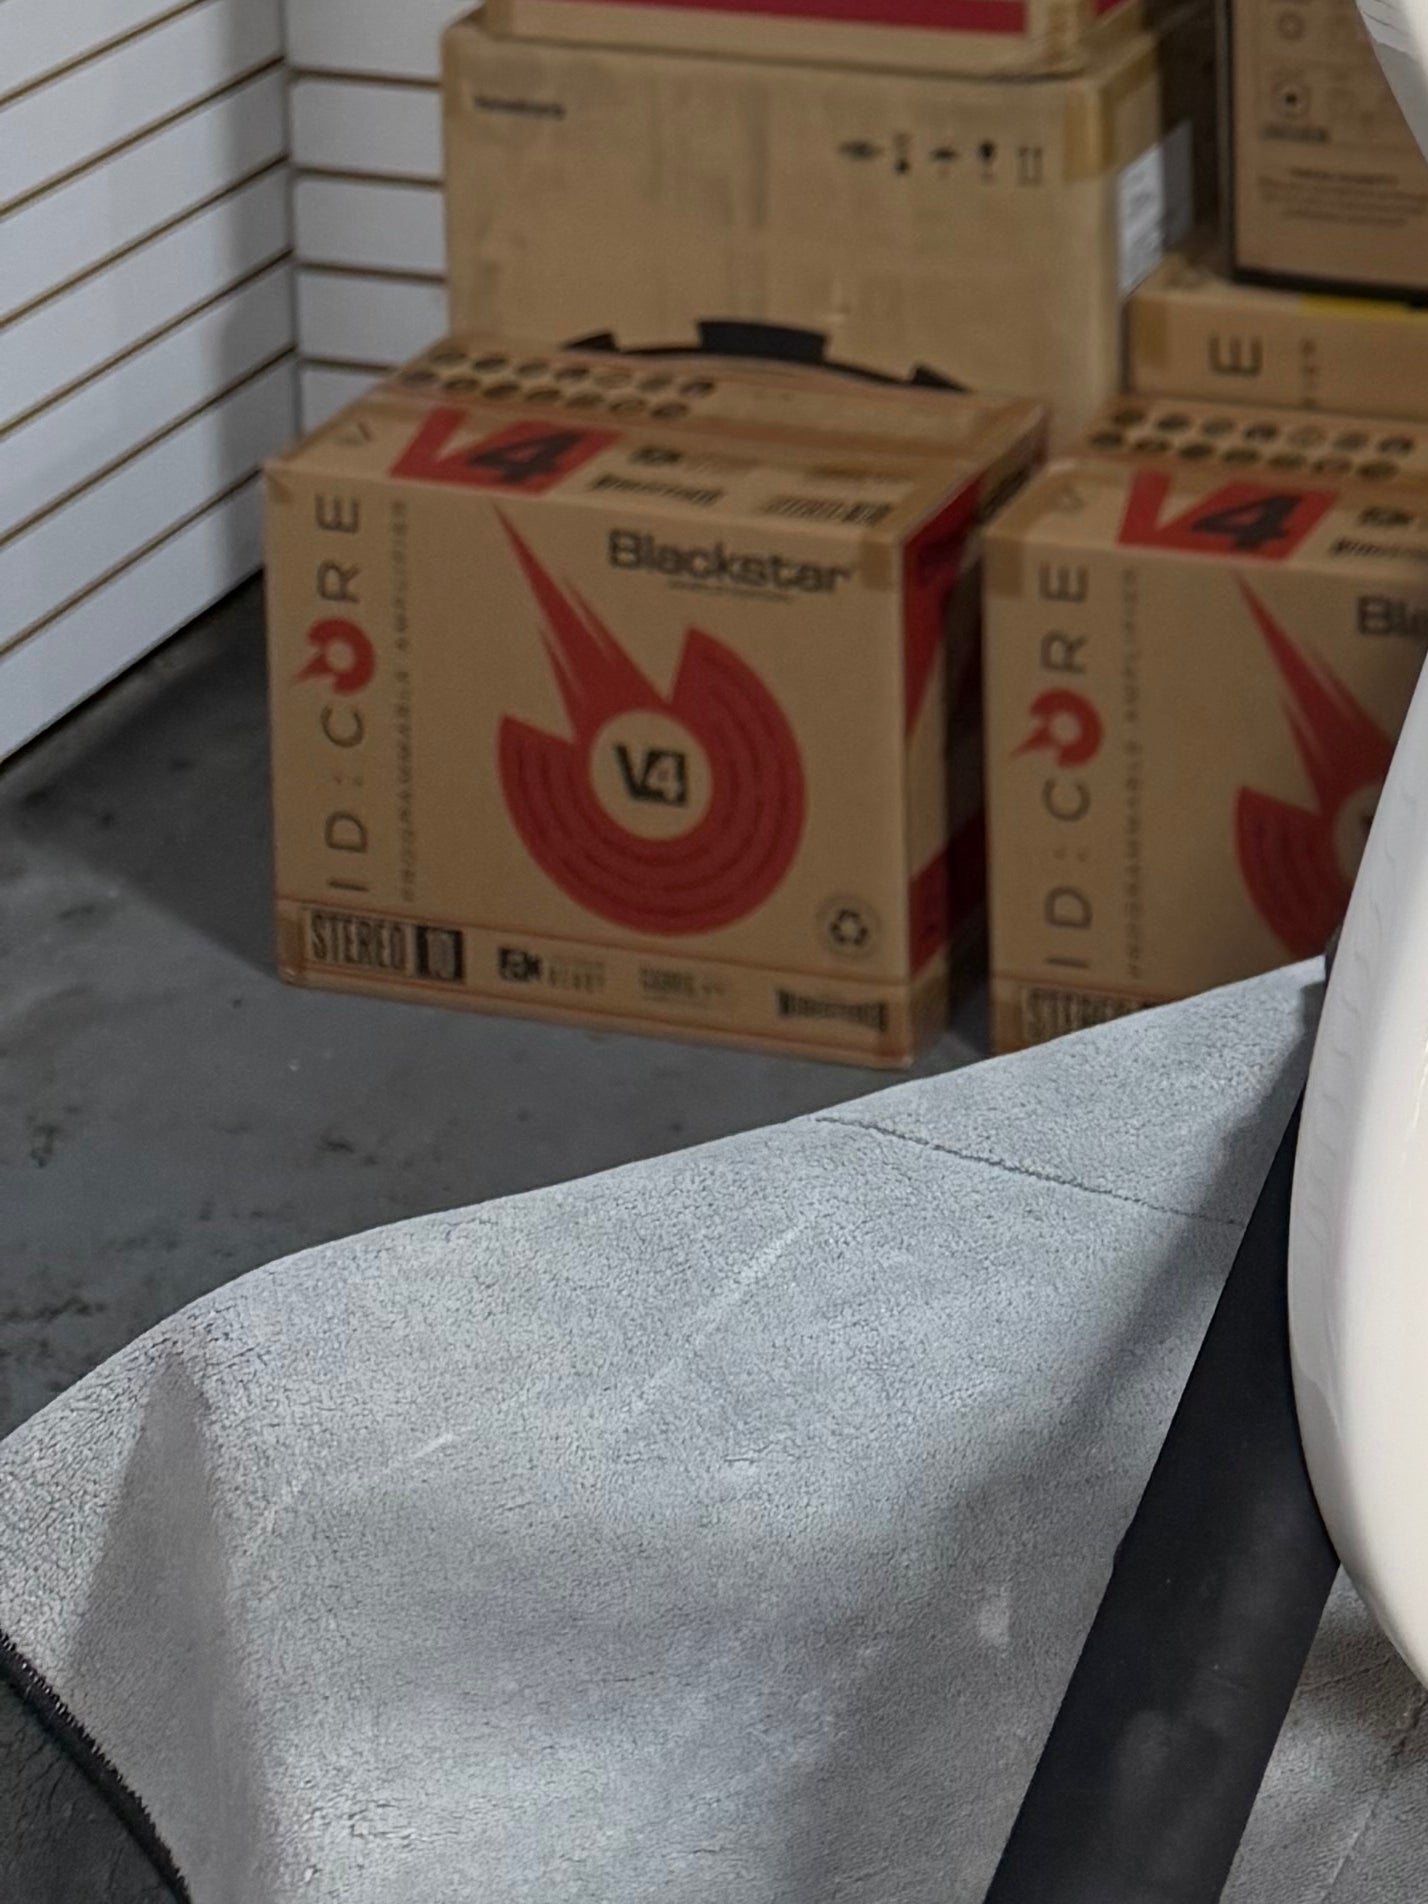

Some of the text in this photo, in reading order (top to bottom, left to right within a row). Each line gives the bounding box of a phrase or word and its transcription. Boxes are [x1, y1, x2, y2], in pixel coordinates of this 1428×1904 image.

[608, 527, 851, 594] Blackstar
[613, 742, 688, 808] V4
[310, 911, 405, 972] STEREO
